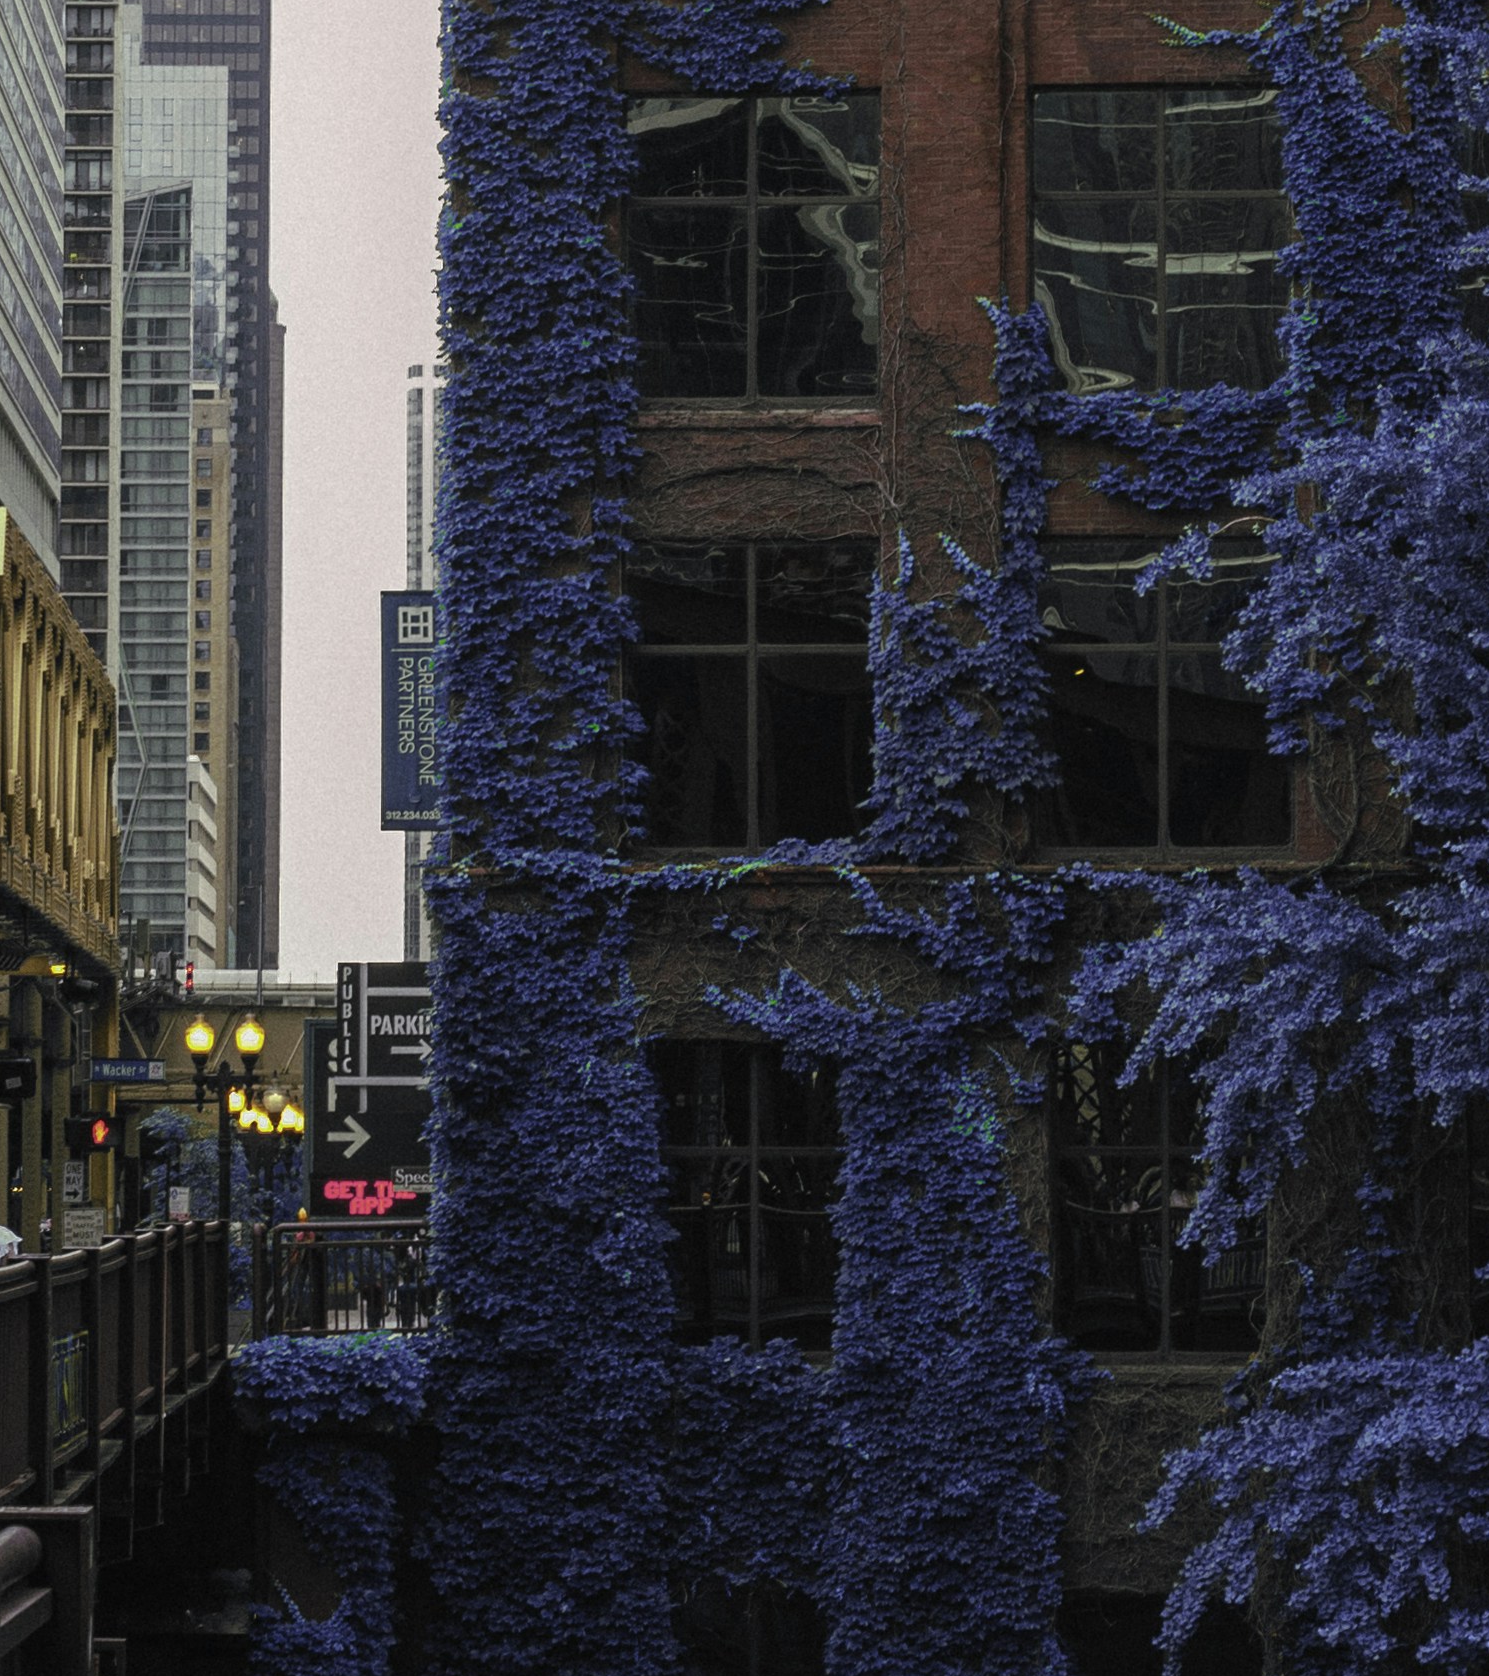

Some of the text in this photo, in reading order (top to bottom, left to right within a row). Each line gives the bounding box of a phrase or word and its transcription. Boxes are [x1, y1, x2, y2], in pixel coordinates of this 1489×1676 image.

[398, 658, 415, 754] PARTNERS
[418, 657, 435, 787] GREENSTONE
[385, 810, 441, 820] 312.234.033
[342, 967, 352, 1074] PUBLIC
[371, 1015, 431, 1035] PARKI
[102, 1063, 136, 1076] Wacker
[66, 1164, 82, 1174] ONE
[65, 1175, 82, 1185] WAY
[324, 1180, 368, 1199] GET
[349, 1198, 393, 1215] APP
